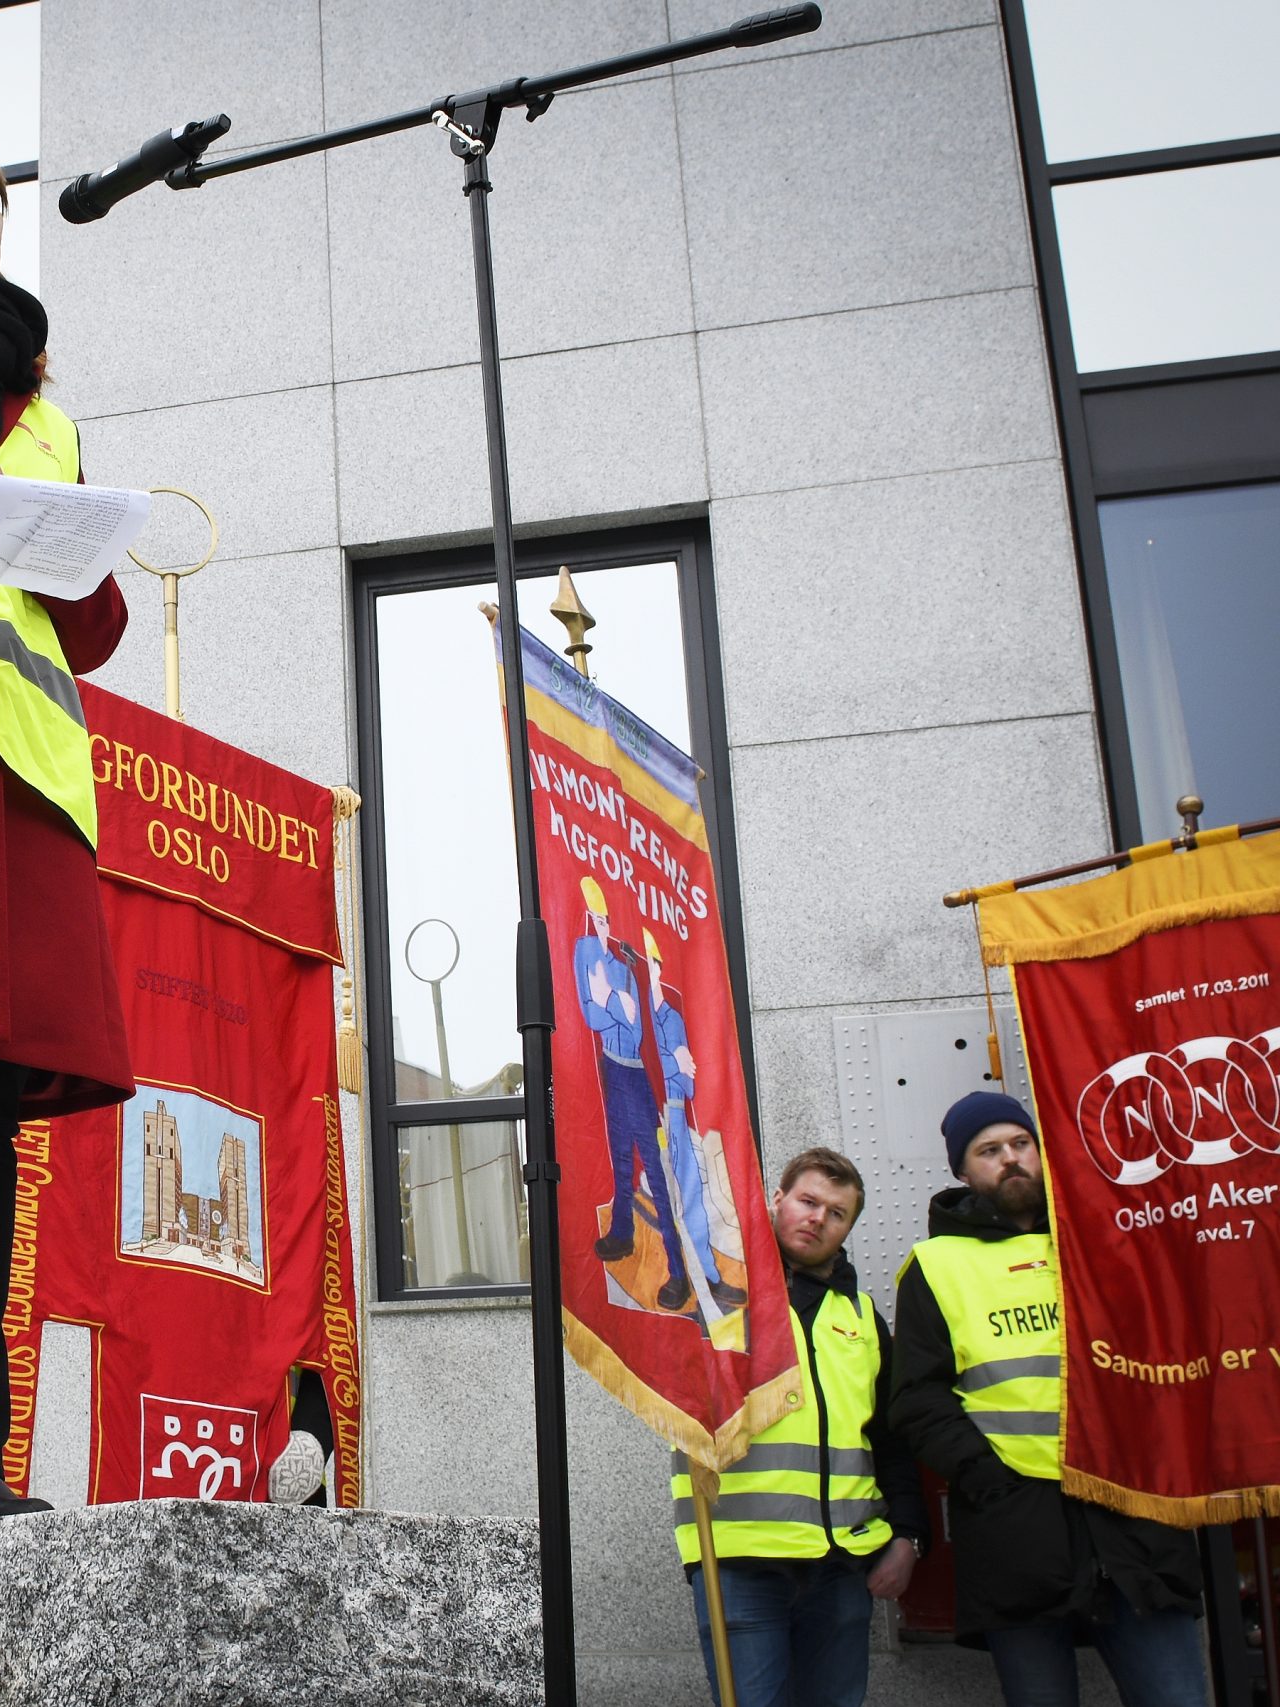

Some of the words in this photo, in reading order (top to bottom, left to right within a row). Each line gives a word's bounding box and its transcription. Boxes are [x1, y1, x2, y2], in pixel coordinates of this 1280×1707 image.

[89, 733, 319, 870] GFORBUNDET
[147, 819, 230, 883] OSLO
[529, 749, 708, 920] NSMONTRENES
[1192, 972, 1270, 998] 17.03.2011
[1115, 1201, 1165, 1232] Oslo
[1170, 1194, 1198, 1221] og
[1207, 1181, 1279, 1209] Aker
[988, 1302, 1060, 1337] STREIK
[1091, 1339, 1210, 1385] Sammen
[1221, 1348, 1257, 1370] er
